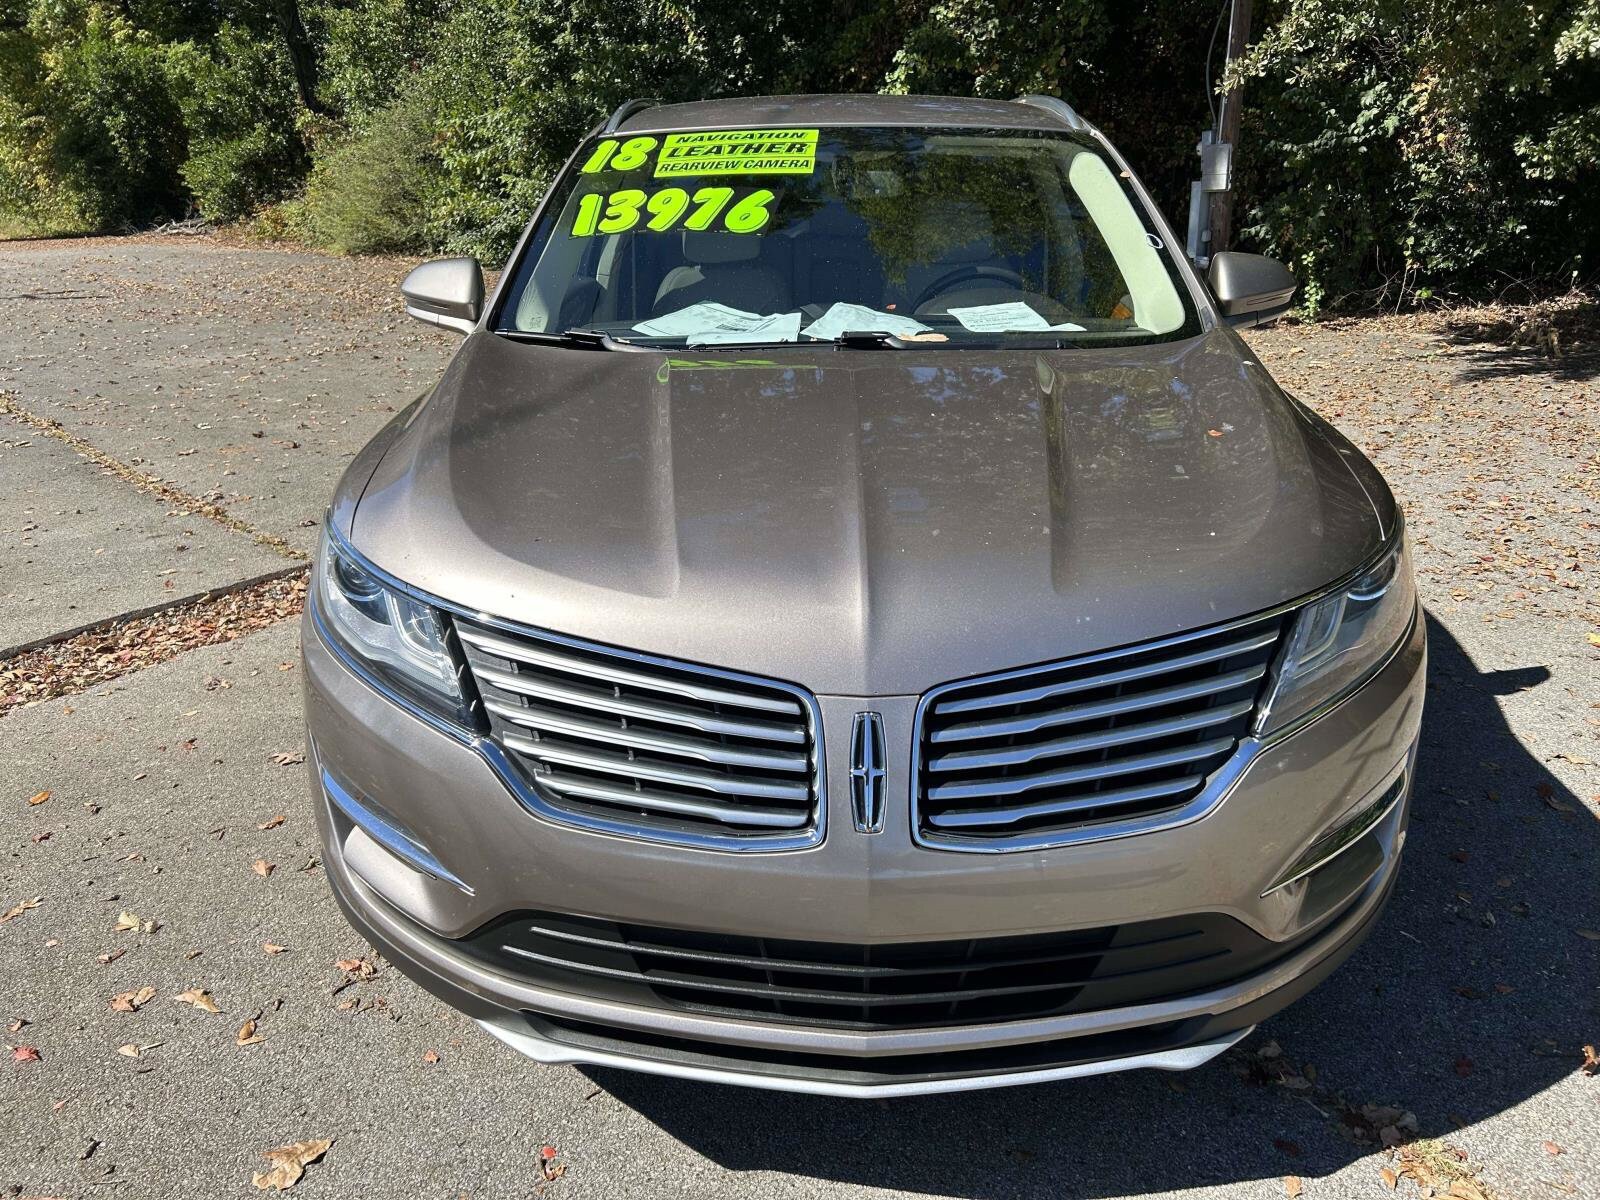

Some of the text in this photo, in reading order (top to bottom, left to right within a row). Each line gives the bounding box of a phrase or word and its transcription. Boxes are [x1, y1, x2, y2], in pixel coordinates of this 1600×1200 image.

[675, 132, 806, 143] NAVIGATION
[581, 137, 658, 173] 18
[666, 143, 809, 158] LEATHER
[659, 159, 810, 172] REARVIEW CAMERA
[571, 187, 775, 236] 13976
